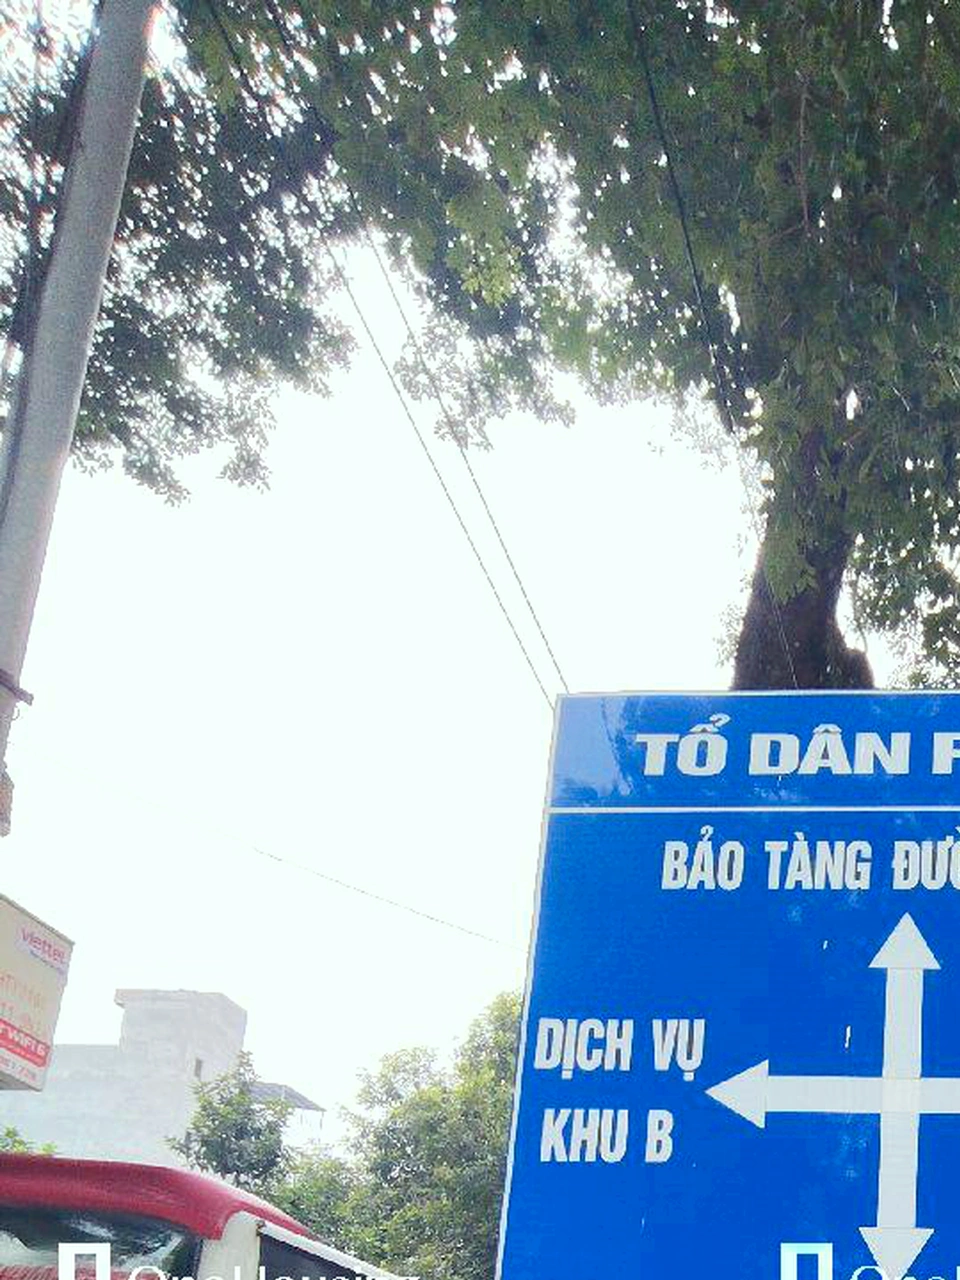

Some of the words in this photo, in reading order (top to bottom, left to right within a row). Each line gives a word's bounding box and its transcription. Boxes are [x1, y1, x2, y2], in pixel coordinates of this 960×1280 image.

[635, 713, 730, 776] TỔ
[748, 724, 911, 775] DÂN
[661, 825, 745, 891] BẢO
[764, 832, 872, 890] TÀNG
[534, 1018, 634, 1080] DỊCH
[652, 1019, 705, 1081] VỤ
[540, 1109, 629, 1163] KHU
[645, 1109, 674, 1163] B
